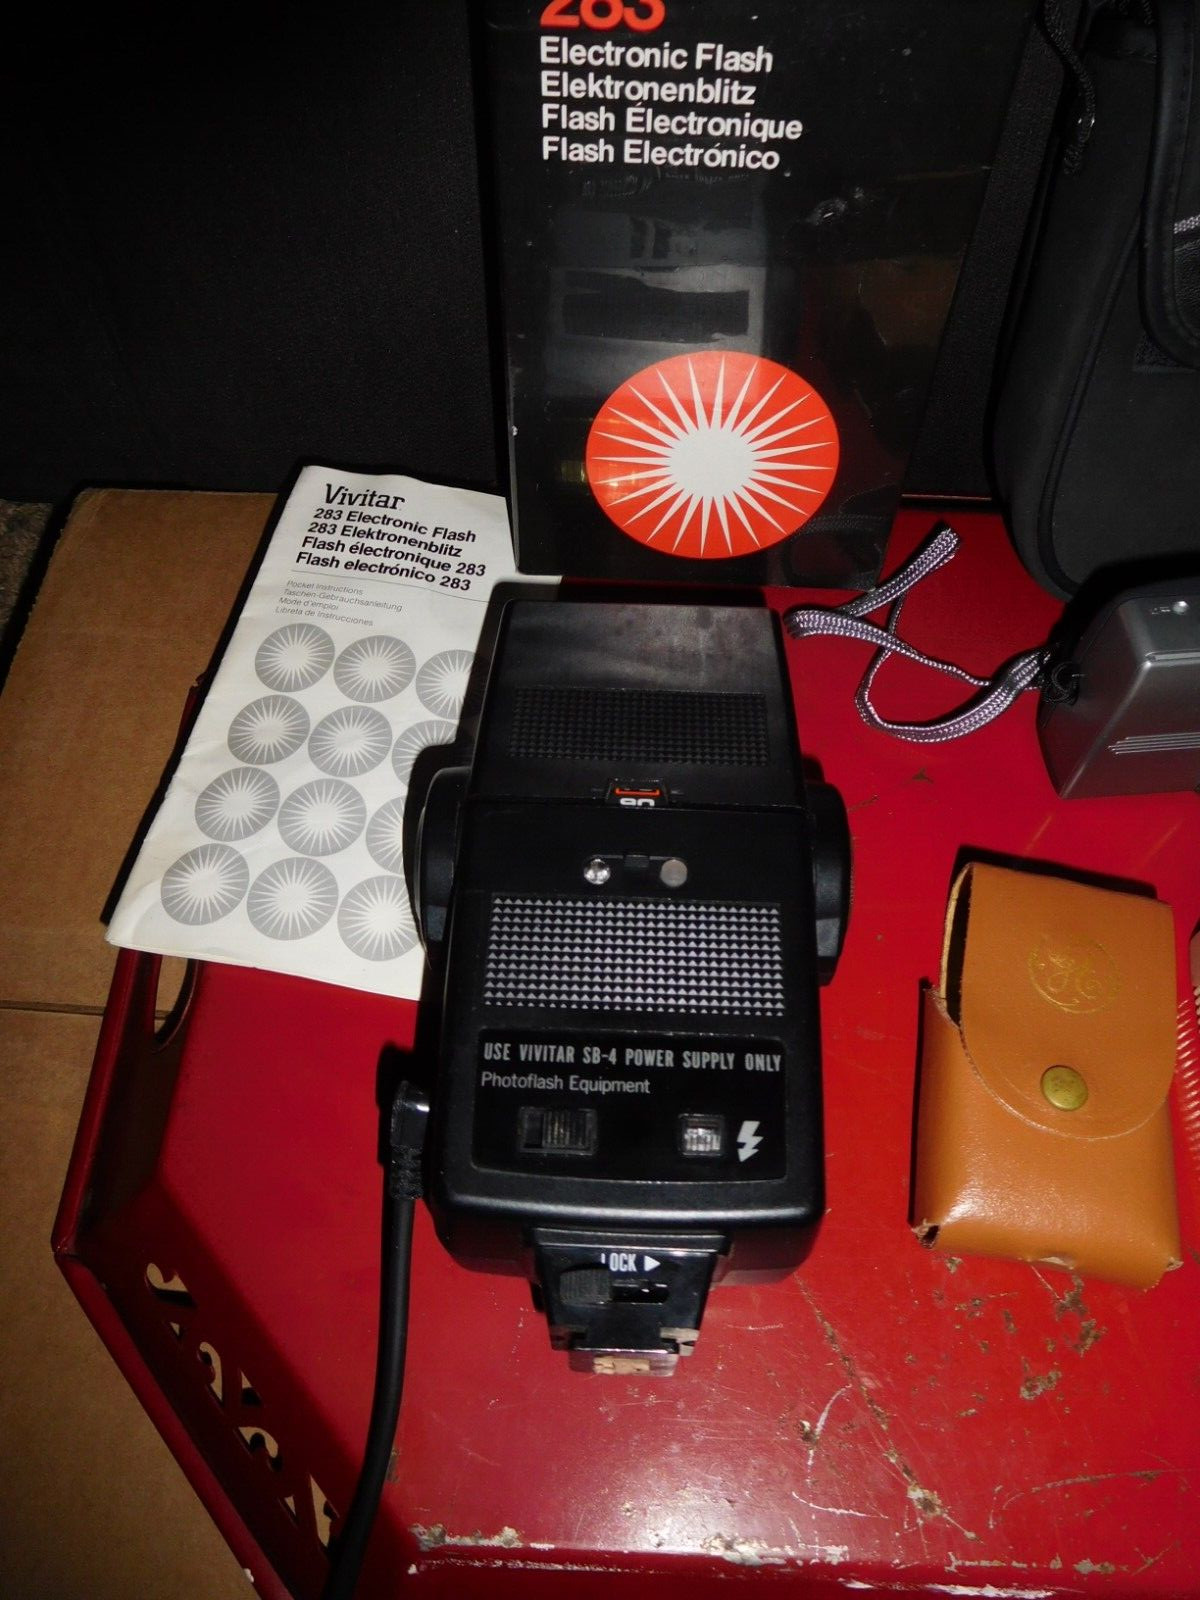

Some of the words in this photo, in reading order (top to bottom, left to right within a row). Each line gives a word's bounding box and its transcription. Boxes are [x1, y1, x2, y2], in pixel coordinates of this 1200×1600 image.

[540, 36, 688, 69] Electronic
[695, 43, 773, 73] Flash
[541, 70, 756, 105] Elektronenblitz
[542, 103, 615, 131] Flash
[626, 102, 803, 143] Électronique
[542, 136, 614, 163] Flash
[623, 139, 780, 170] Electrónico
[325, 483, 405, 510] Vivitar
[308, 522, 336, 536] 283
[341, 525, 462, 558] Elektronenblitz
[314, 508, 342, 521] 283
[346, 511, 428, 536] Electronic
[432, 526, 476, 543] Flash
[296, 551, 340, 570] Flash
[344, 559, 436, 584] electrónico
[440, 575, 471, 591] 283
[302, 536, 346, 554] Flash
[349, 540, 451, 573] électronique
[456, 562, 486, 577] 283
[286, 580, 314, 589] Pocket
[275, 606, 303, 615] Libreta
[305, 609, 316, 617] de
[279, 597, 302, 607] Mode
[483, 1042, 512, 1061] USE
[519, 1044, 575, 1064] VIVITAR
[582, 1047, 617, 1066] SB-4
[624, 1049, 675, 1068] POWER
[682, 1051, 736, 1071] SUPPLY
[745, 1053, 782, 1072] ONLY
[480, 1071, 564, 1090] Photoflash
[569, 1075, 651, 1096] Equipment
